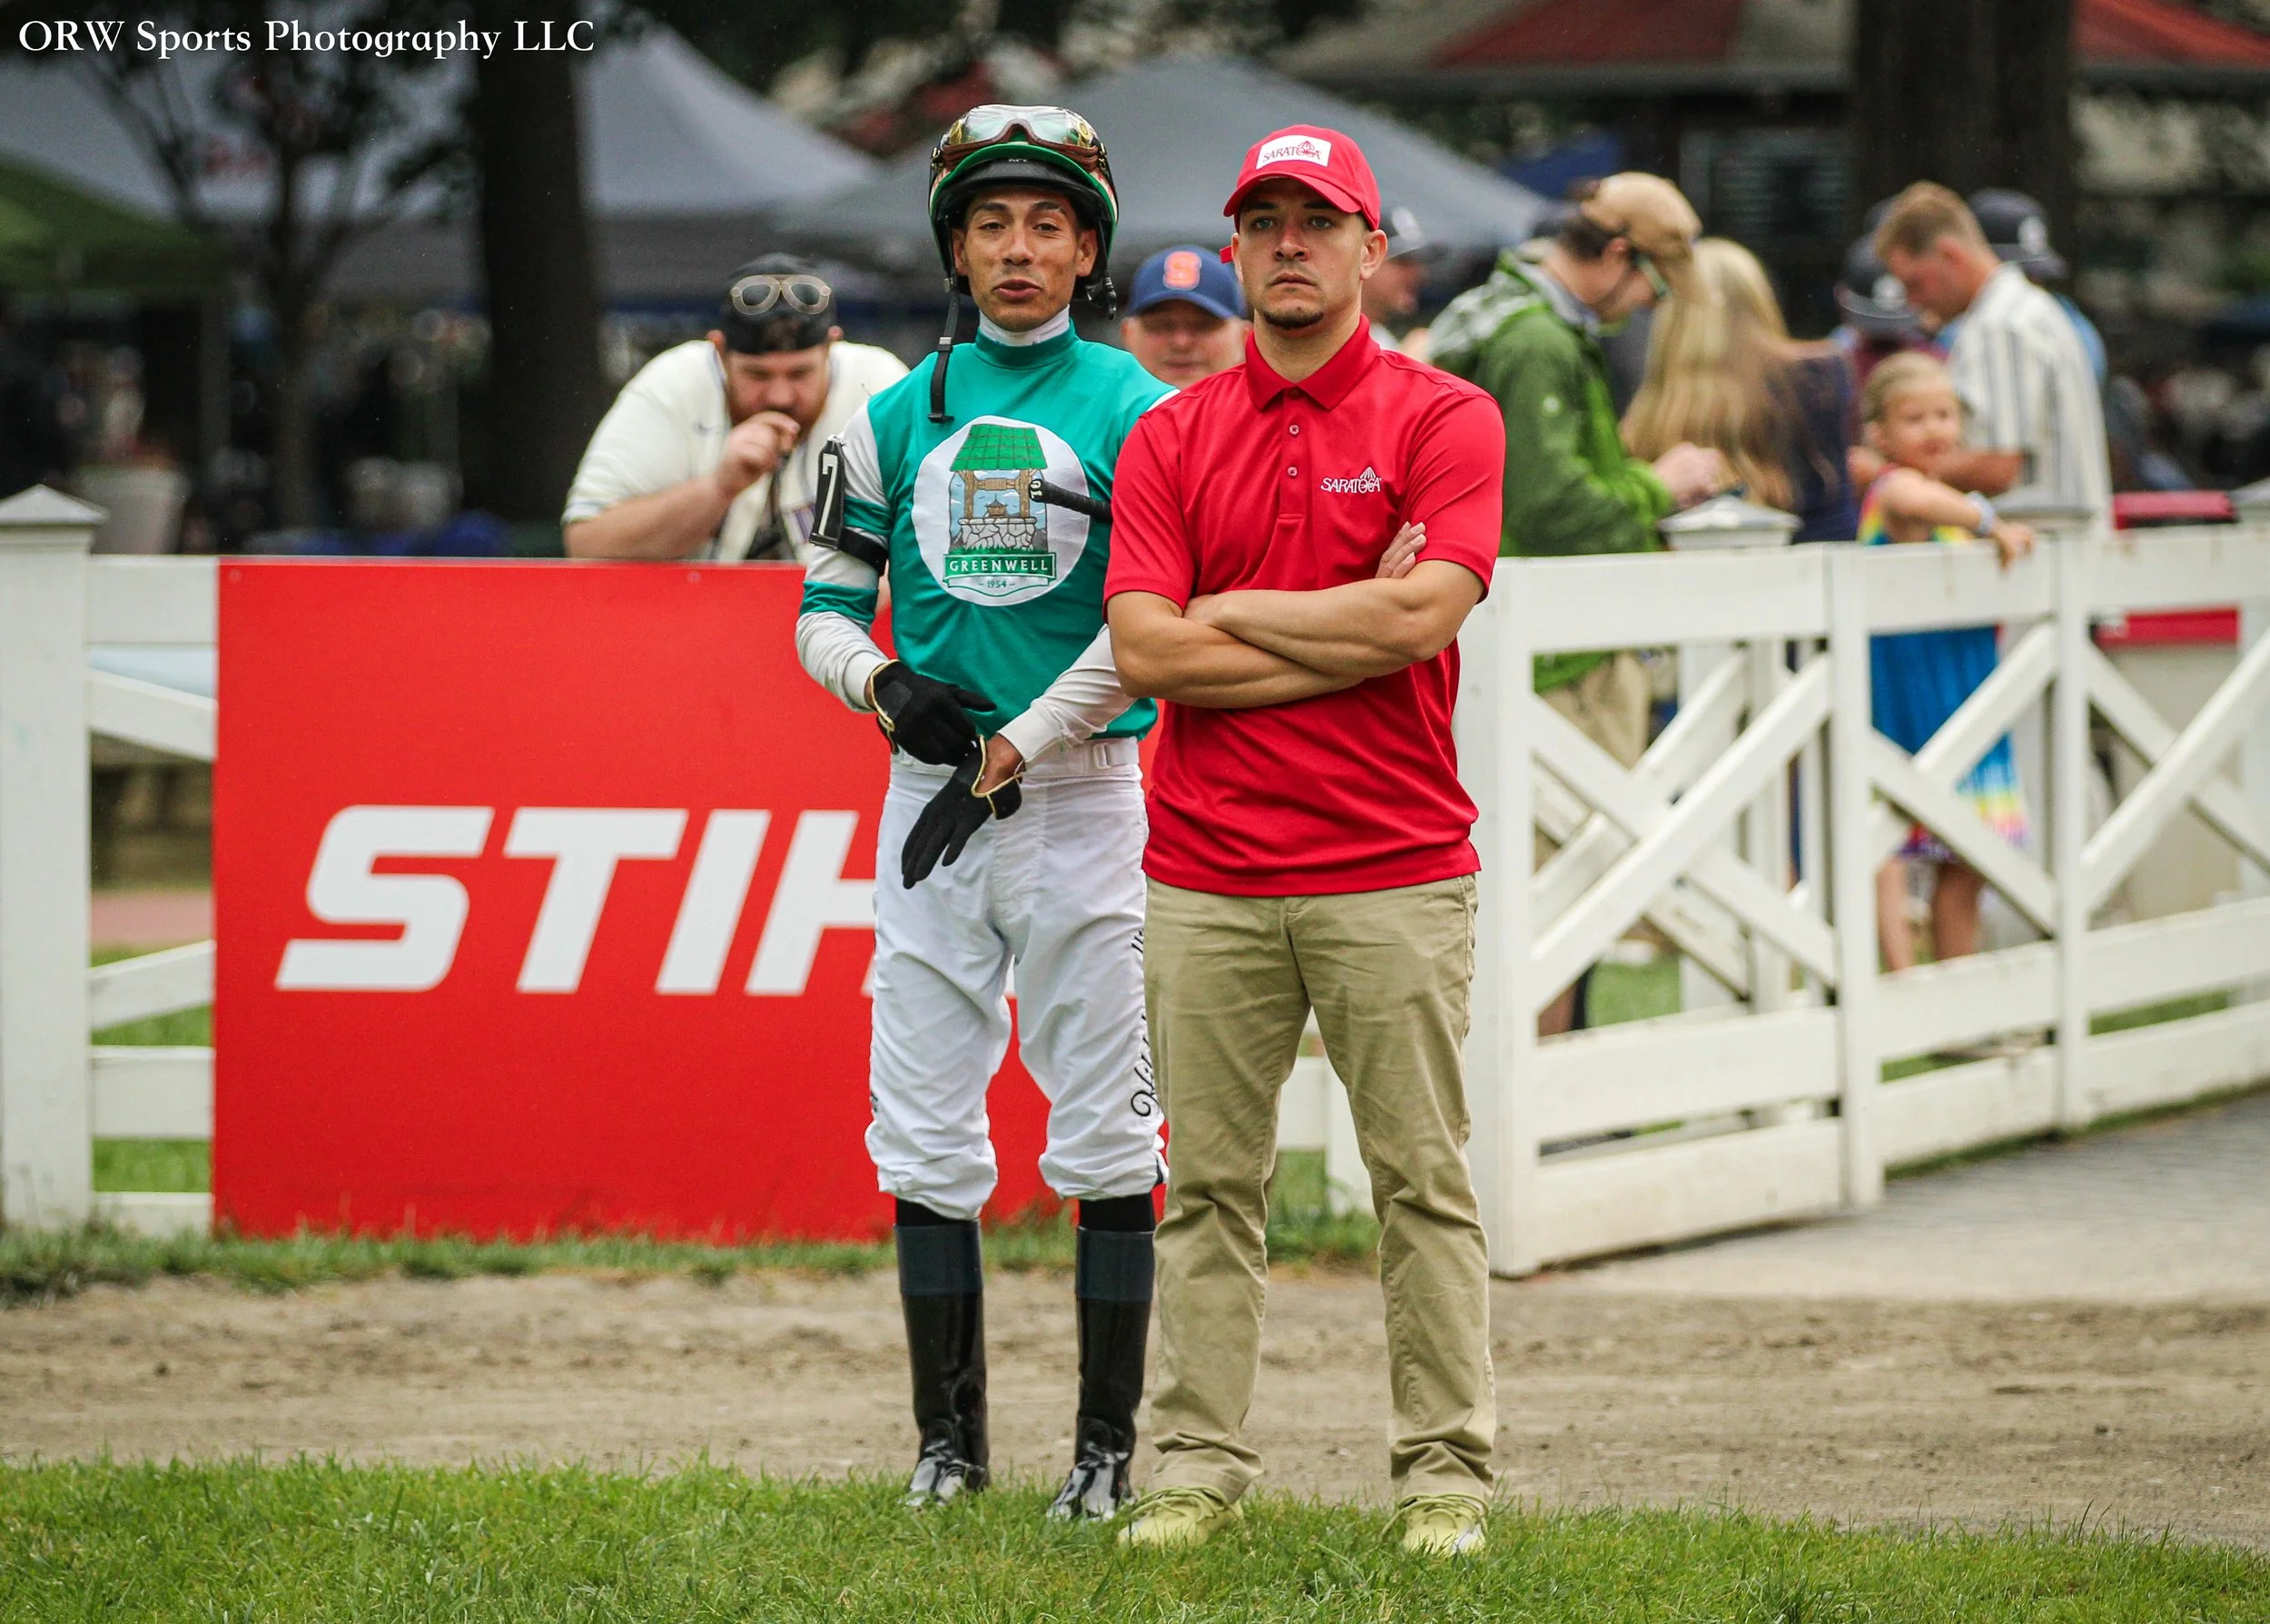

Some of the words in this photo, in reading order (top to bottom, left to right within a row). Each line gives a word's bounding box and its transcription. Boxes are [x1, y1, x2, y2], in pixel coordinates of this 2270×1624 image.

[1262, 144, 1323, 162] SARATOGA
[1320, 475, 1382, 493] SARATOGA
[818, 453, 838, 536] 7
[949, 559, 1049, 572] GREENWELL
[987, 580, 1007, 589] 1954
[274, 804, 878, 997] STIH
